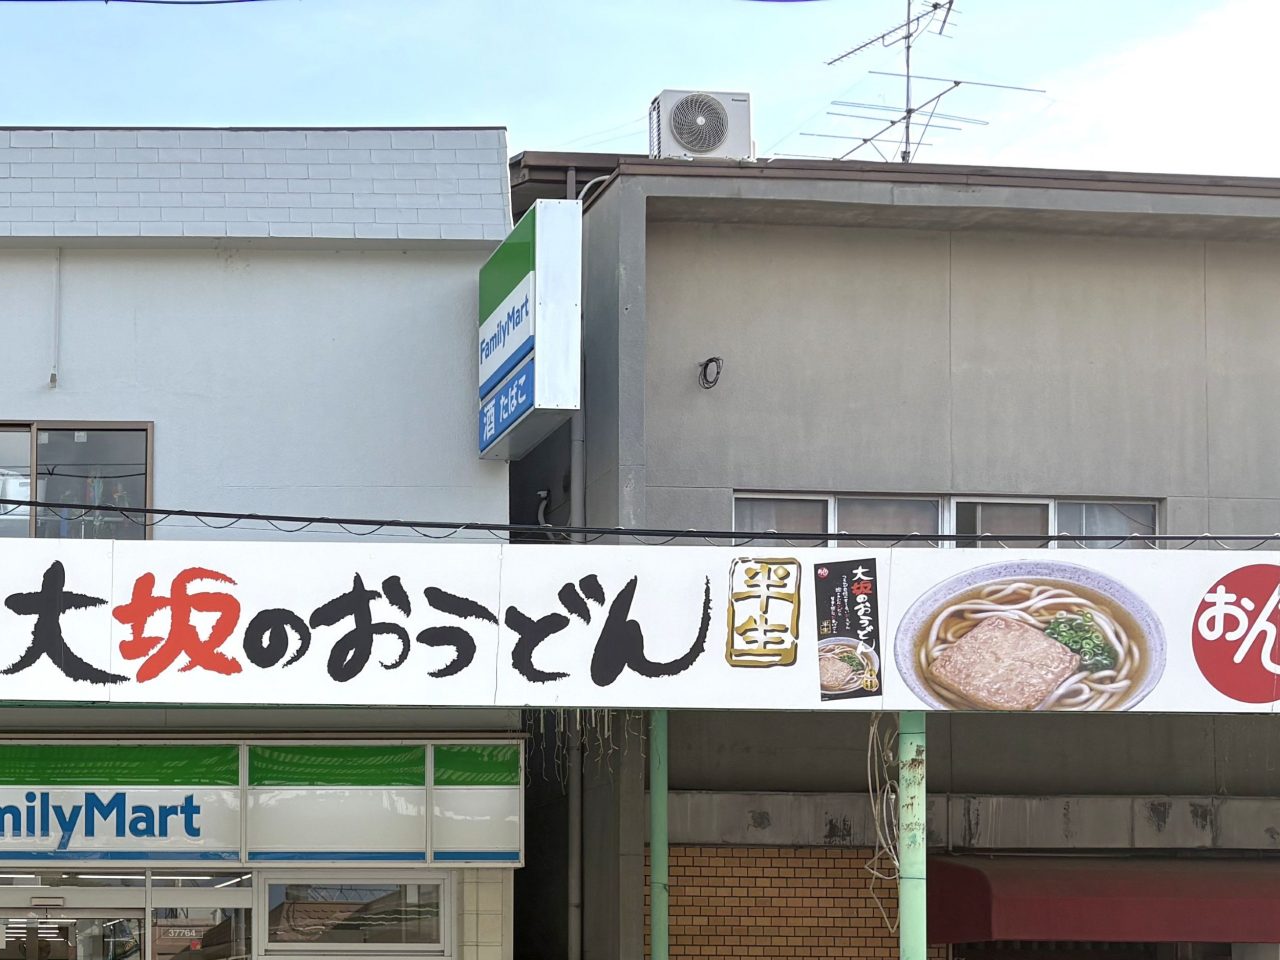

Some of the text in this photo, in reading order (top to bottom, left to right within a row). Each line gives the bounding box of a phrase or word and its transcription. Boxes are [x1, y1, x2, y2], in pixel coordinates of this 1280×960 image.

[480, 294, 529, 365] FamilyMart
[483, 374, 527, 441] 酒 たばこ
[0, 560, 712, 687] 大坂のおうどん
[1198, 584, 1280, 675] おん
[168, 929, 196, 937] 37764
